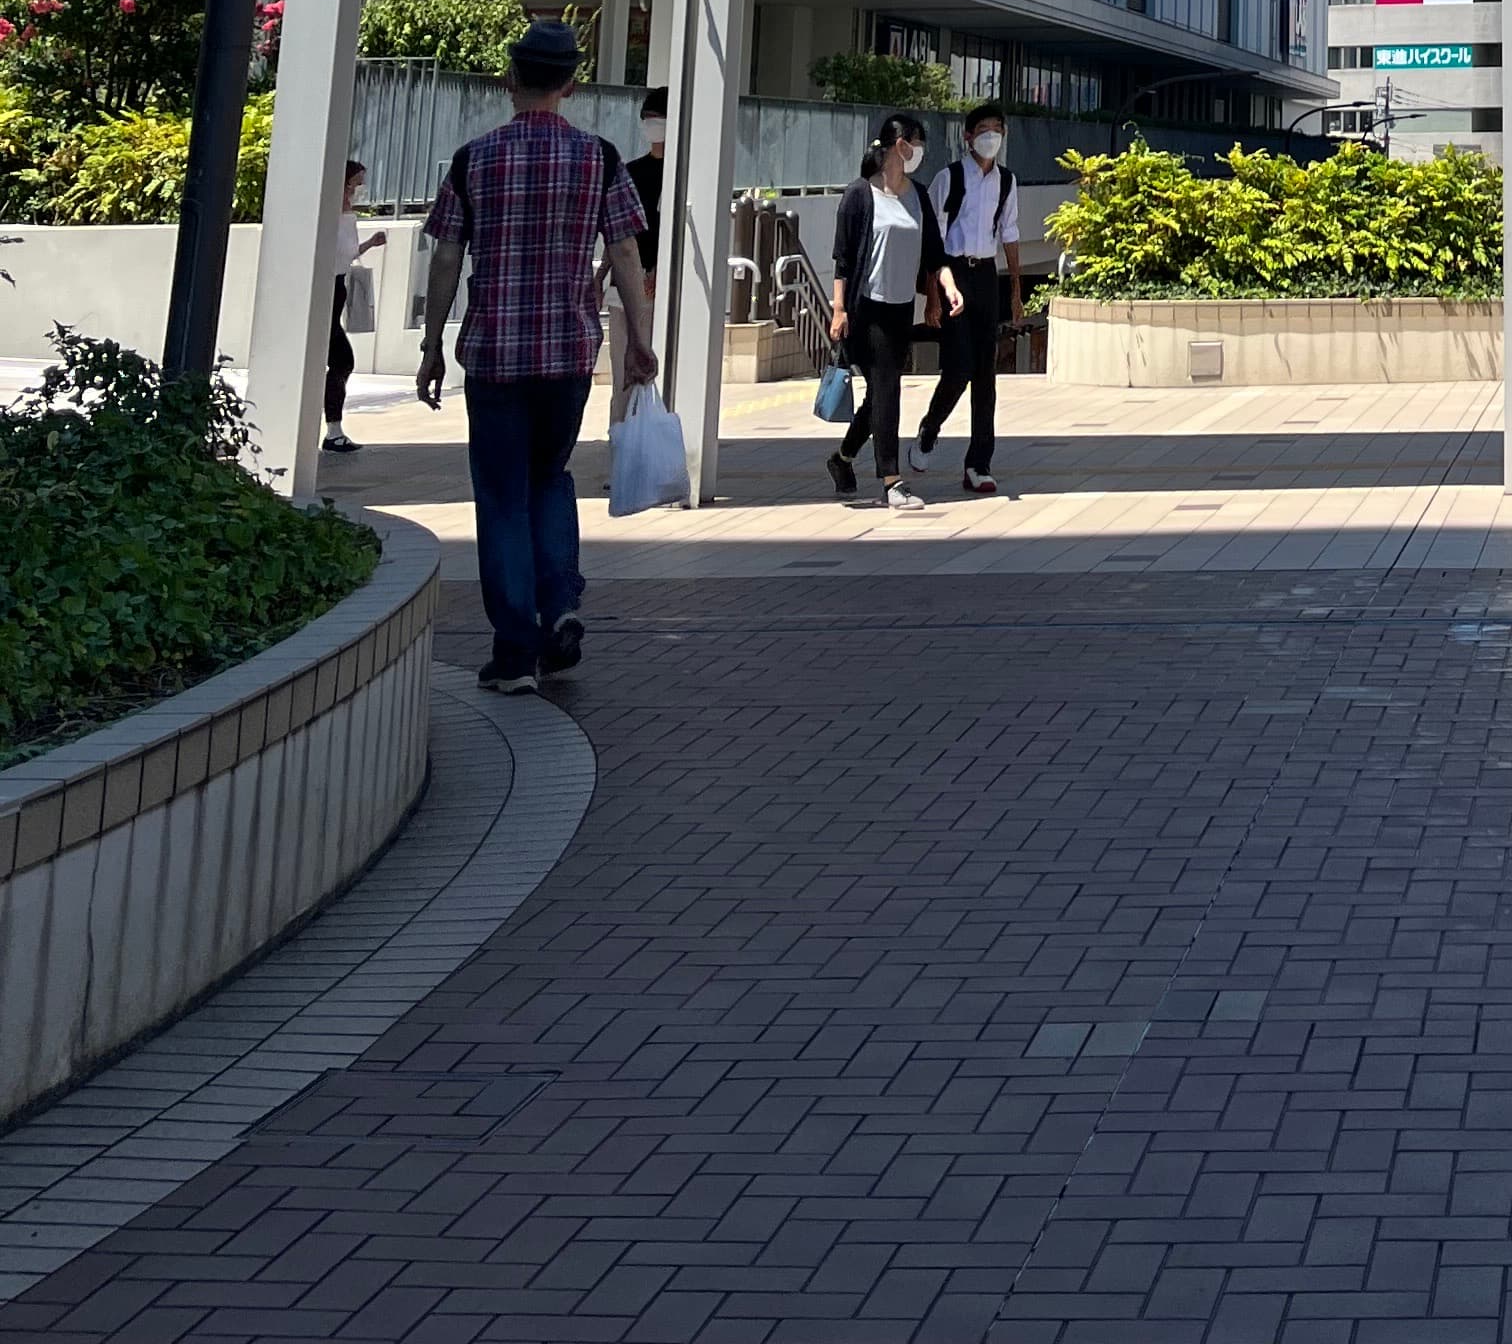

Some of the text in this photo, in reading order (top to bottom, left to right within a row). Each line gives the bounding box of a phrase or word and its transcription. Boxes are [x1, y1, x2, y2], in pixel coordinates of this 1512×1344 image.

[1376, 47, 1472, 66] 東進ハイスクール
